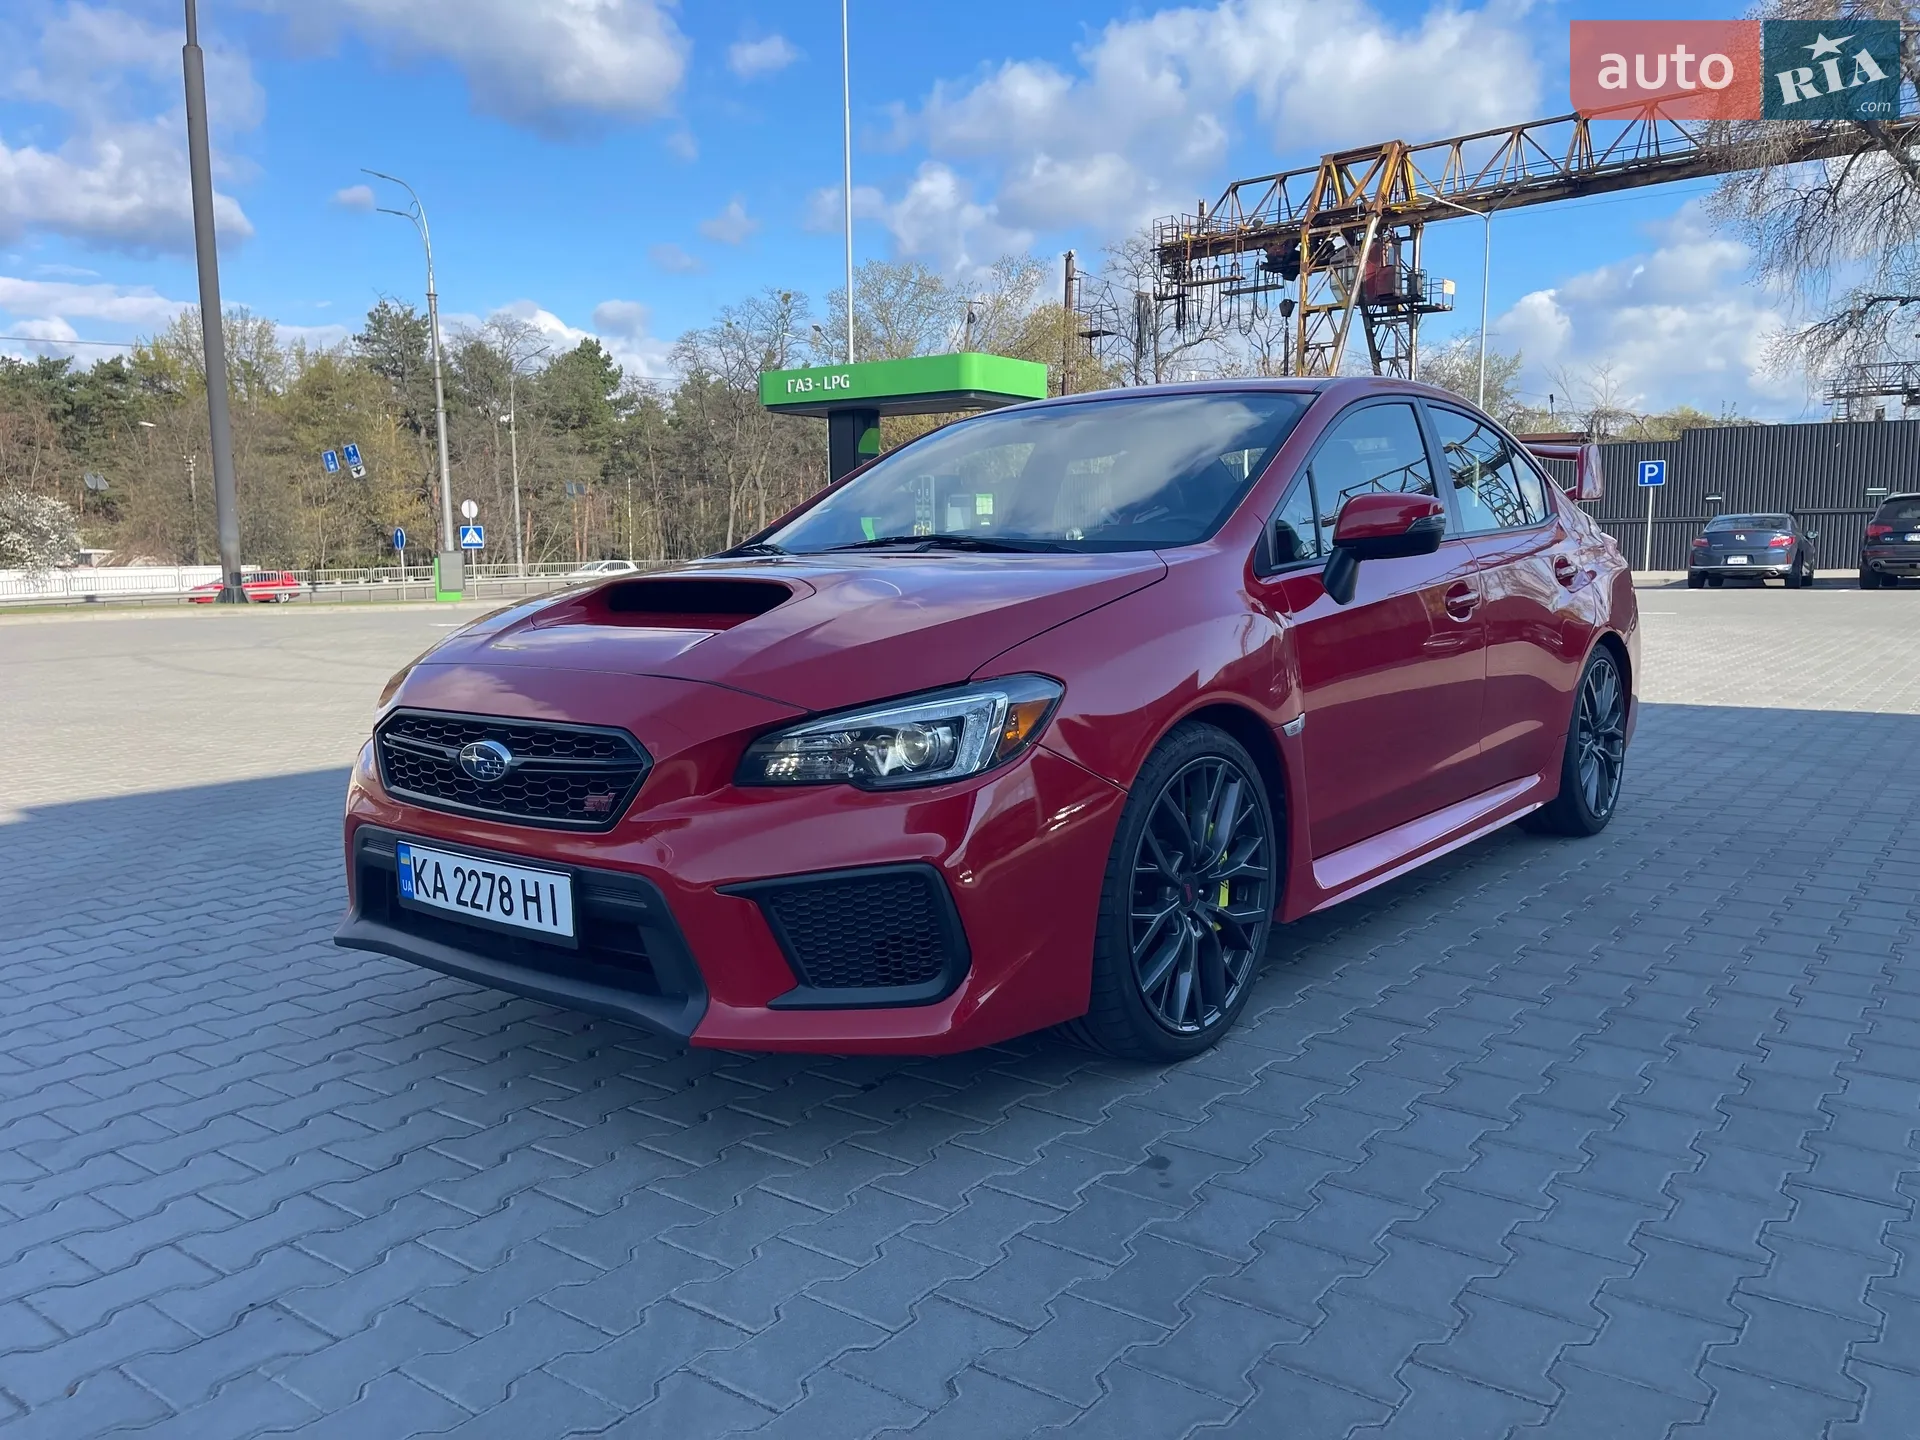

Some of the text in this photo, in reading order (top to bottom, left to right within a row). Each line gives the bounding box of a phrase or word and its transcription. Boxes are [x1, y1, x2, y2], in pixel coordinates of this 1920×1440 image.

[787, 378, 813, 393] ГАЗ
[823, 374, 850, 389] LPG
[1644, 464, 1659, 483] P
[402, 879, 413, 893] UA
[412, 856, 558, 926] KA 2278 HI
